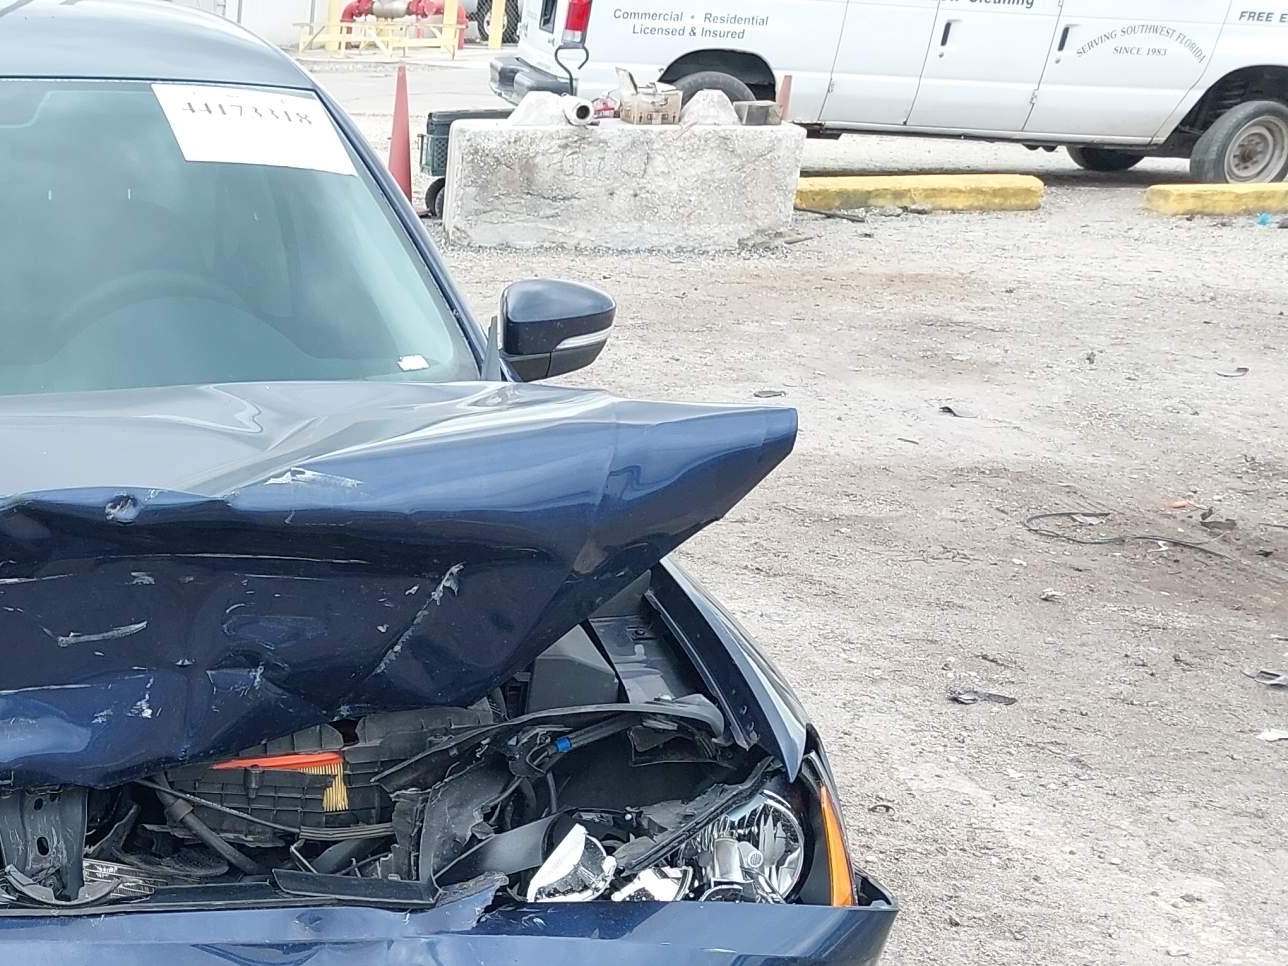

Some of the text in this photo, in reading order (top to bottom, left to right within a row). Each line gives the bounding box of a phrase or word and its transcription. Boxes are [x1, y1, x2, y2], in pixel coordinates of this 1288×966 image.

[613, 8, 769, 26] Commercial Residential
[1238, 10, 1275, 22] FREE
[632, 23, 746, 40] Licensed & Insured
[1076, 24, 1207, 64] SERVING SOUTHWEST FLORIDA
[1112, 46, 1143, 56] SINCE
